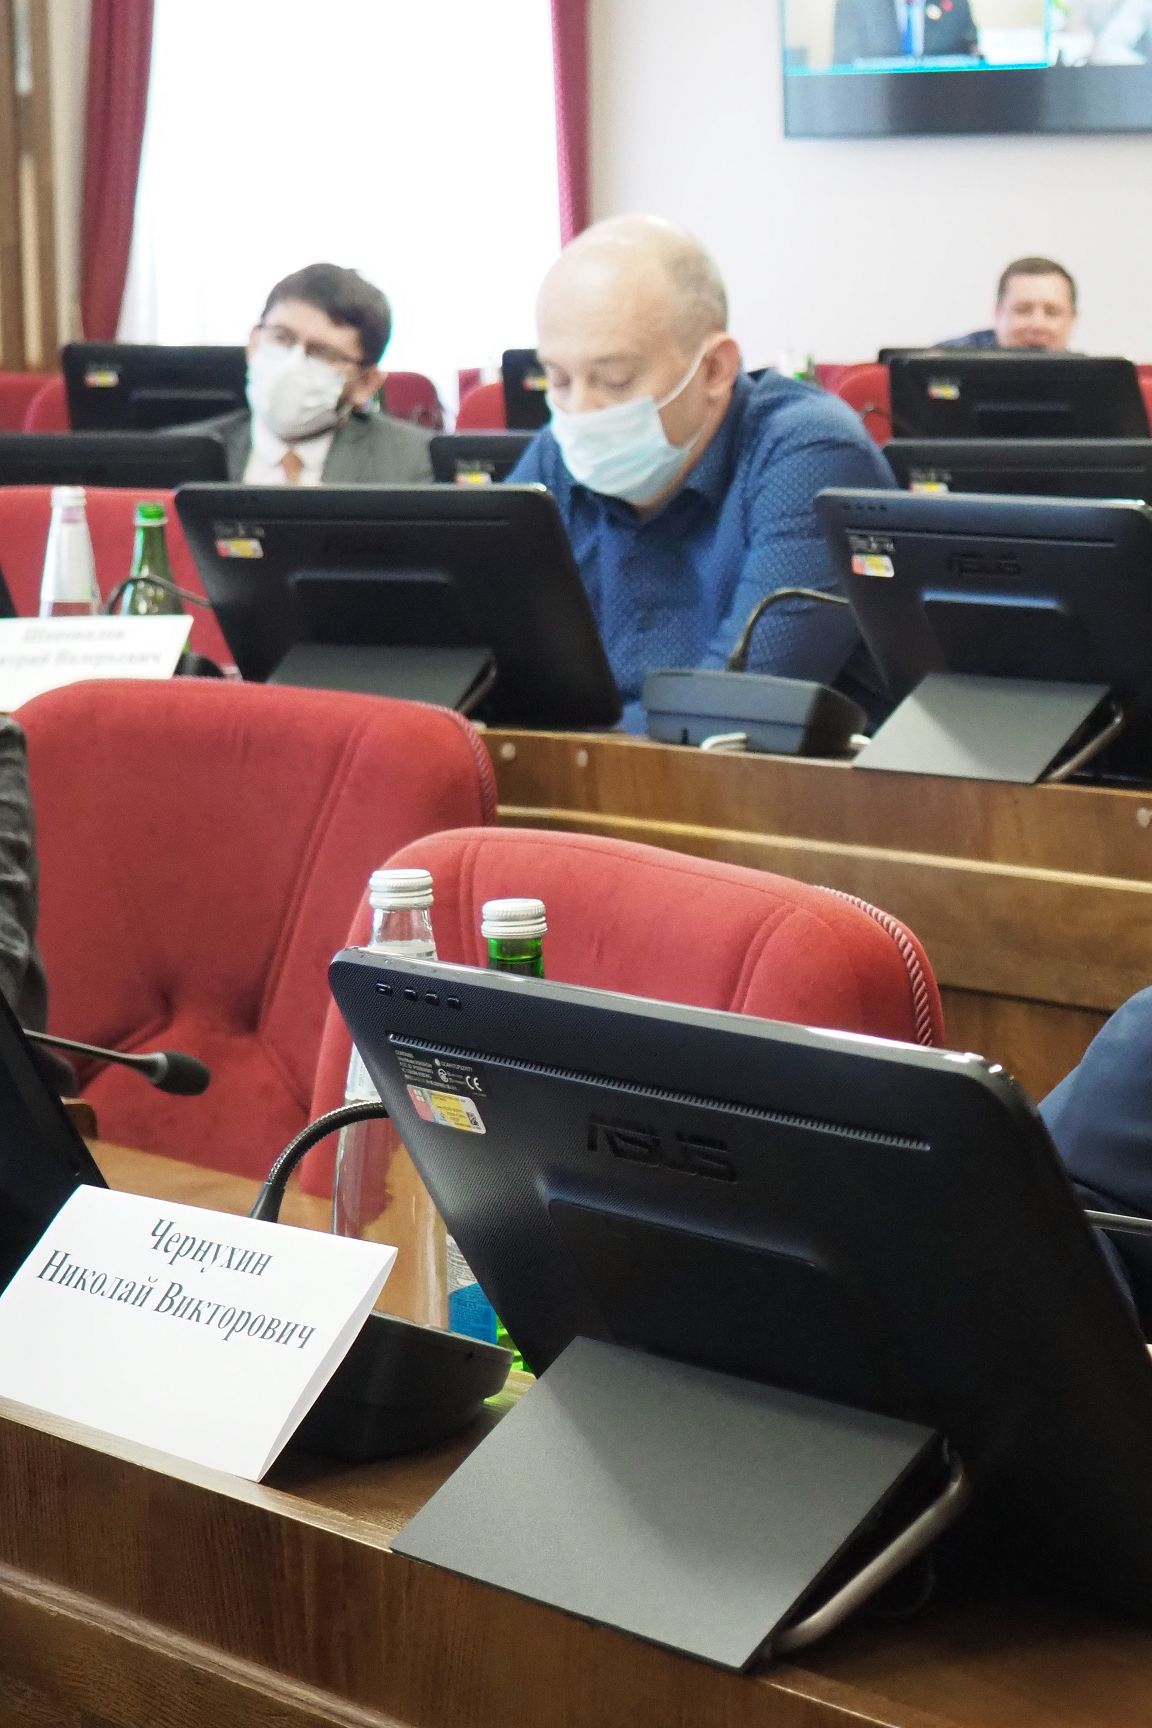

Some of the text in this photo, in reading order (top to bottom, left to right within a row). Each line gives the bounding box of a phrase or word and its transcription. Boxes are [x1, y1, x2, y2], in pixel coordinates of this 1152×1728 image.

[150, 1217, 274, 1276] Чернухин
[36, 1249, 317, 1350] Николай Викторович
